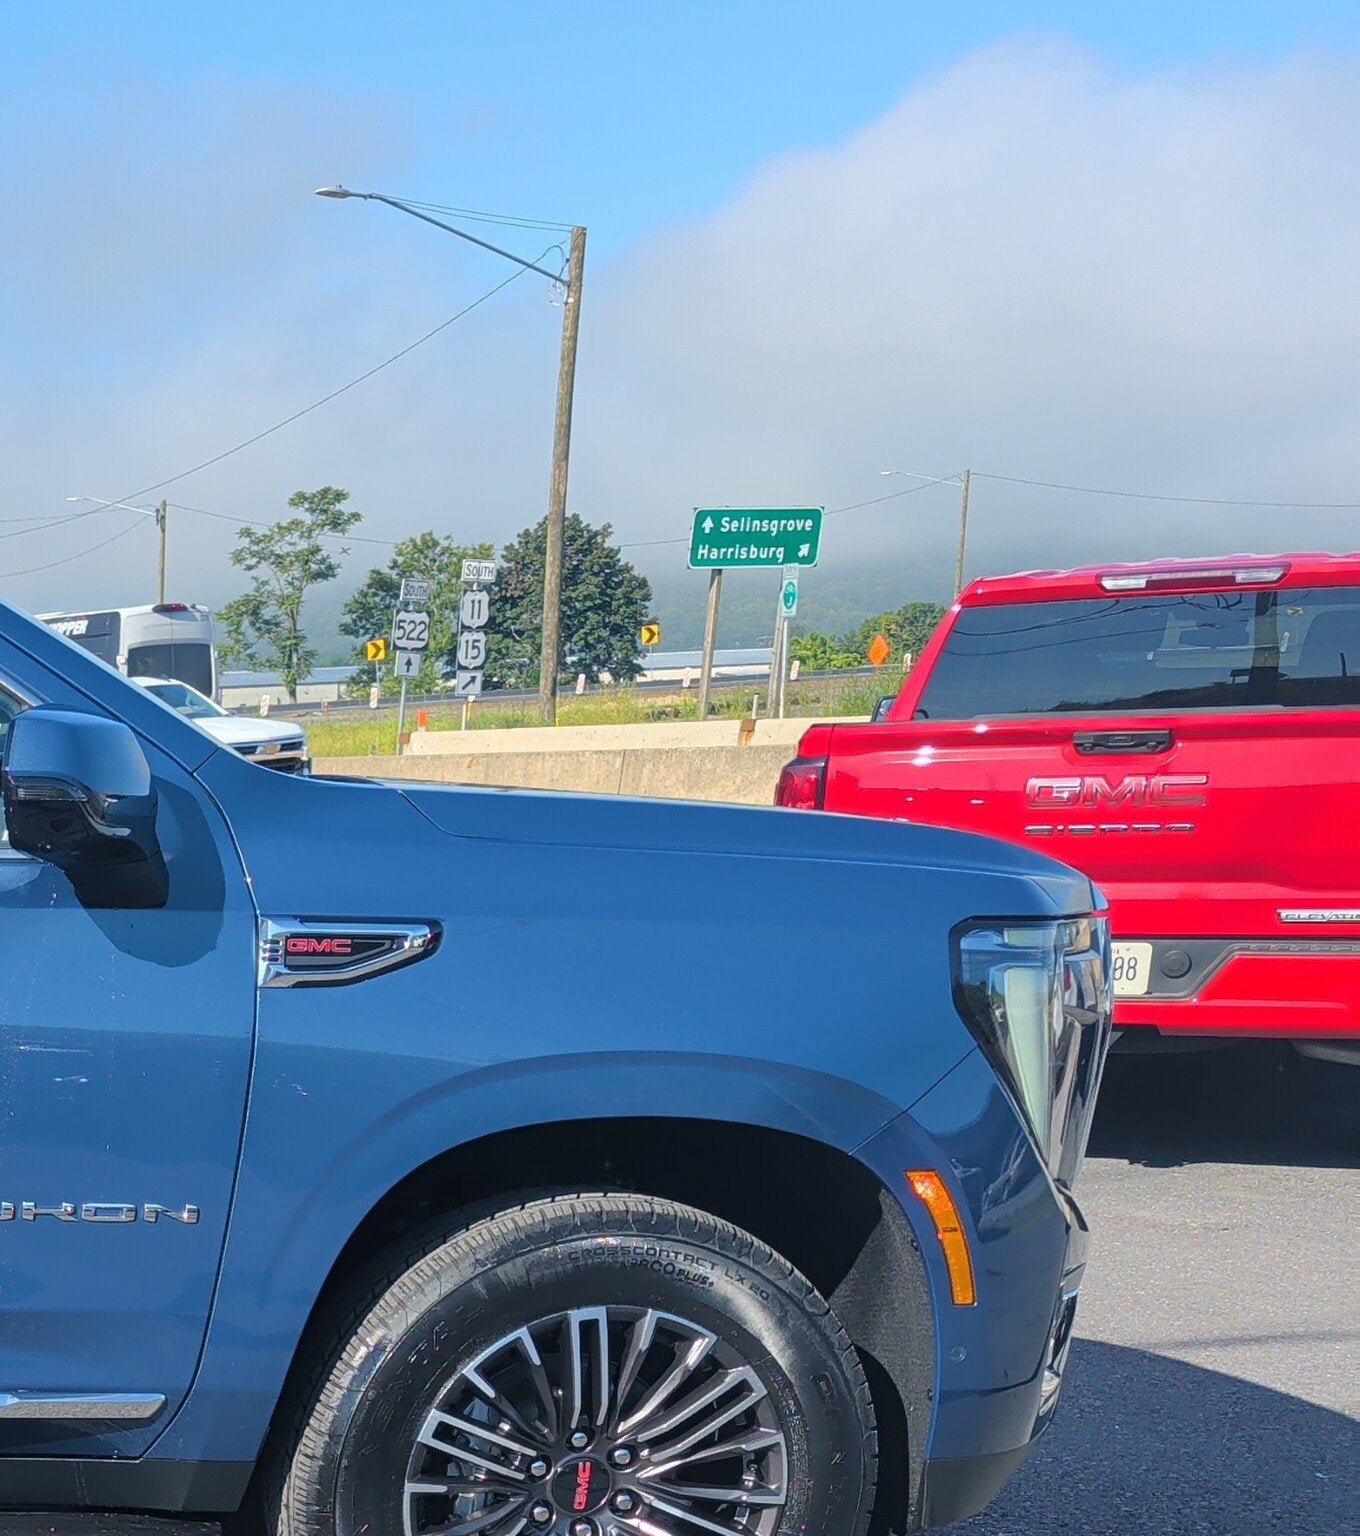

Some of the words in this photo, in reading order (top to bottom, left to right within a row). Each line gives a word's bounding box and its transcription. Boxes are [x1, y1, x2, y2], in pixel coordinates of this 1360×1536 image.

[720, 516, 813, 536] Selinsgrove
[697, 544, 784, 563] Harrisburg
[465, 563, 495, 578] SOUTH
[404, 583, 428, 597] SOUTH
[470, 598, 482, 620] 11
[396, 619, 428, 641] 522
[464, 639, 482, 659] 15
[1025, 774, 1208, 810] GMC
[286, 937, 352, 954] GMC
[573, 1461, 591, 1510] GMC
